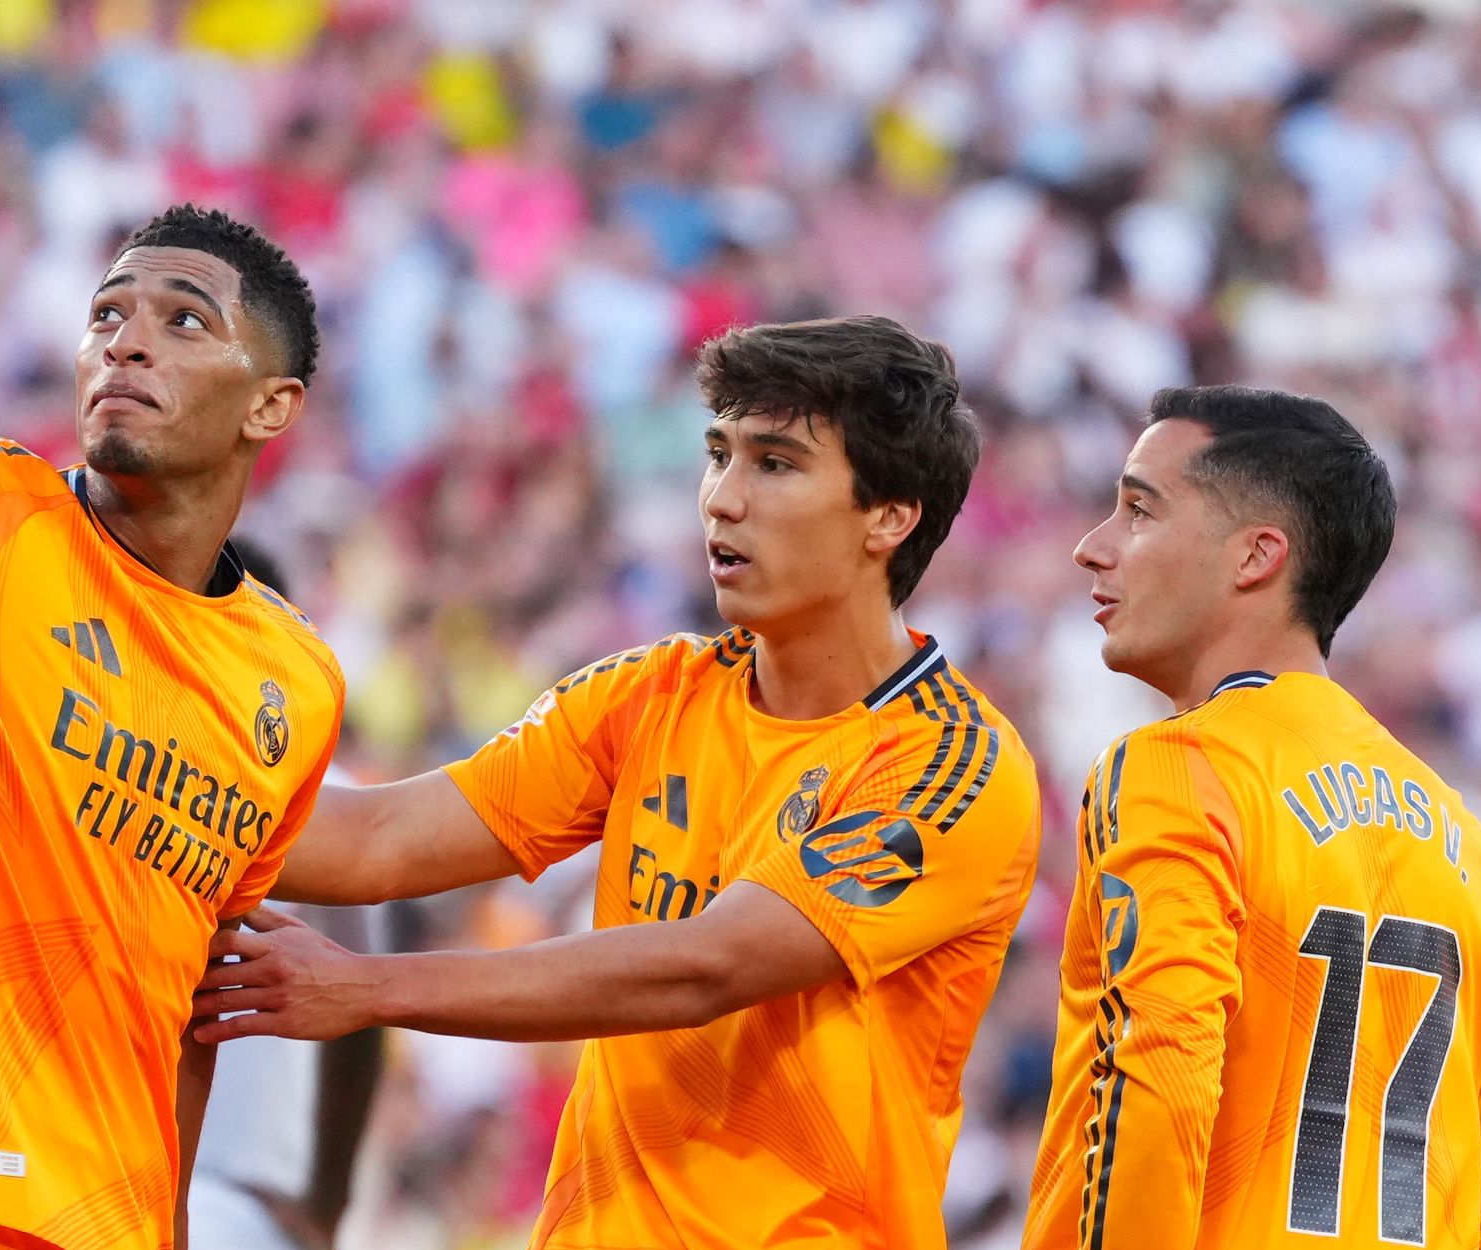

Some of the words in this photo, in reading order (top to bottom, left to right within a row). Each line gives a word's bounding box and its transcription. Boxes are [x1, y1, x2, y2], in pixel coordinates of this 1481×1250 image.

[50, 687, 273, 857] Emirates
[76, 783, 137, 845] FLY
[134, 812, 231, 903] BETTER
[1280, 760, 1433, 848] LUCAS
[1441, 806, 1470, 886] V.
[1285, 905, 1463, 1247] 17
